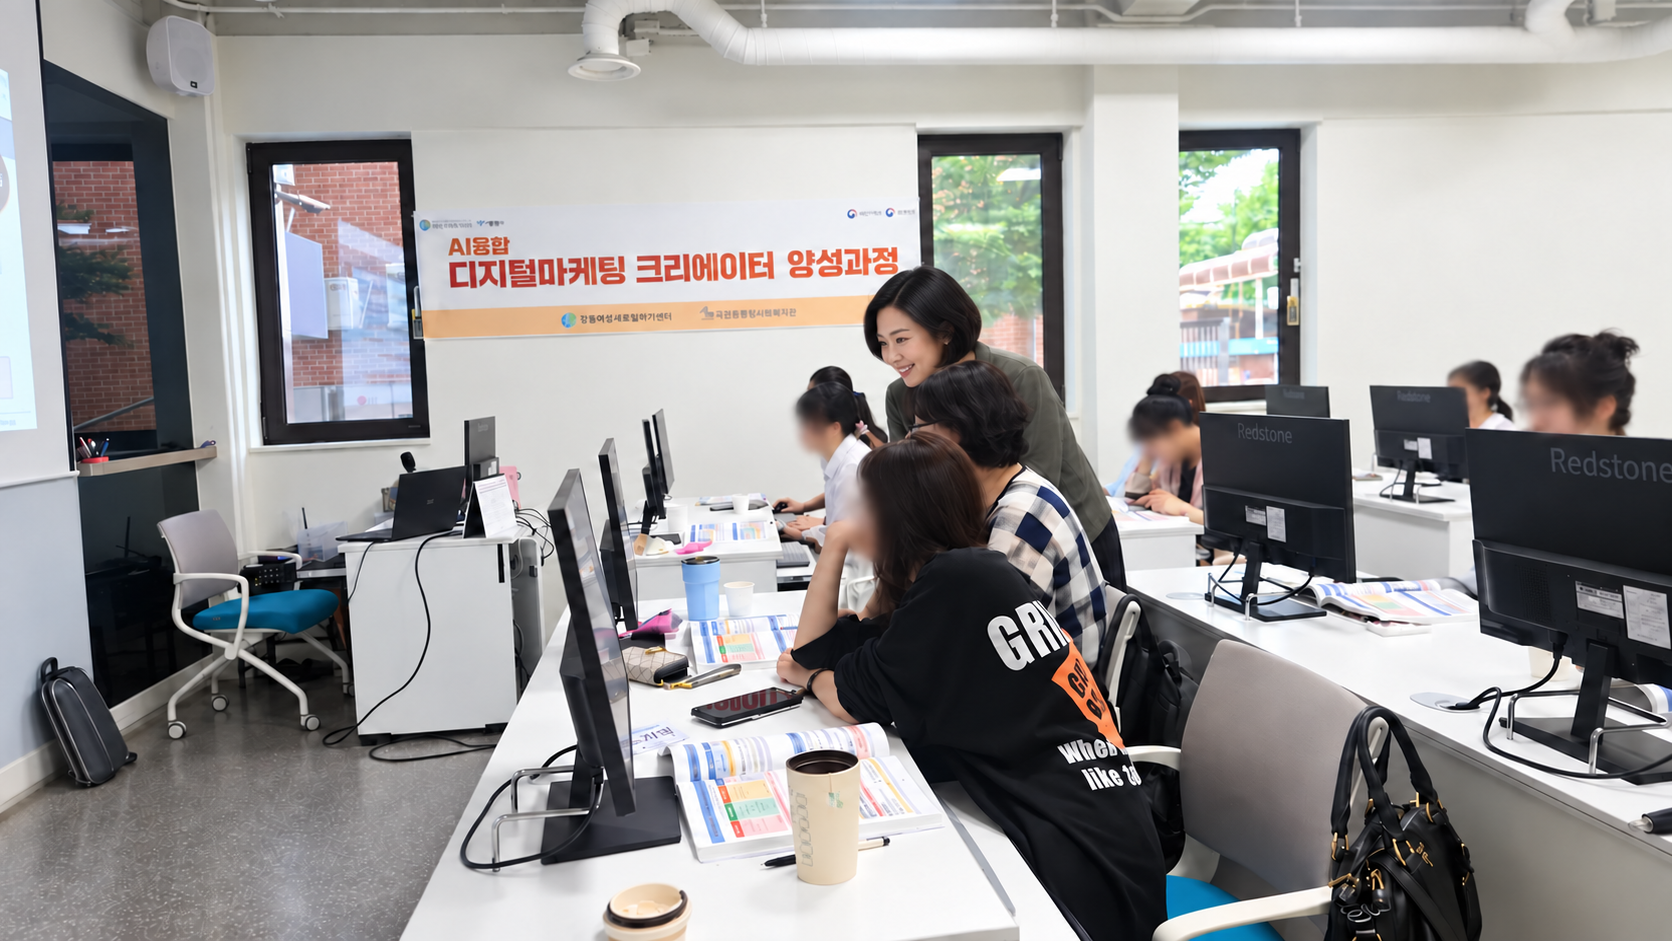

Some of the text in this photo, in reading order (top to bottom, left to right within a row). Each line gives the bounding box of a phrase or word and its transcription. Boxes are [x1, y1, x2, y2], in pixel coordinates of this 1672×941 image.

[448, 236, 510, 256] AI융합
[449, 246, 899, 289] 디지털마케팅 크리에이터 양성과정
[1237, 422, 1293, 444] Redstone
[1550, 447, 1672, 484] Redstone
[987, 600, 1071, 671] GRI
[1081, 766, 1124, 791] like
